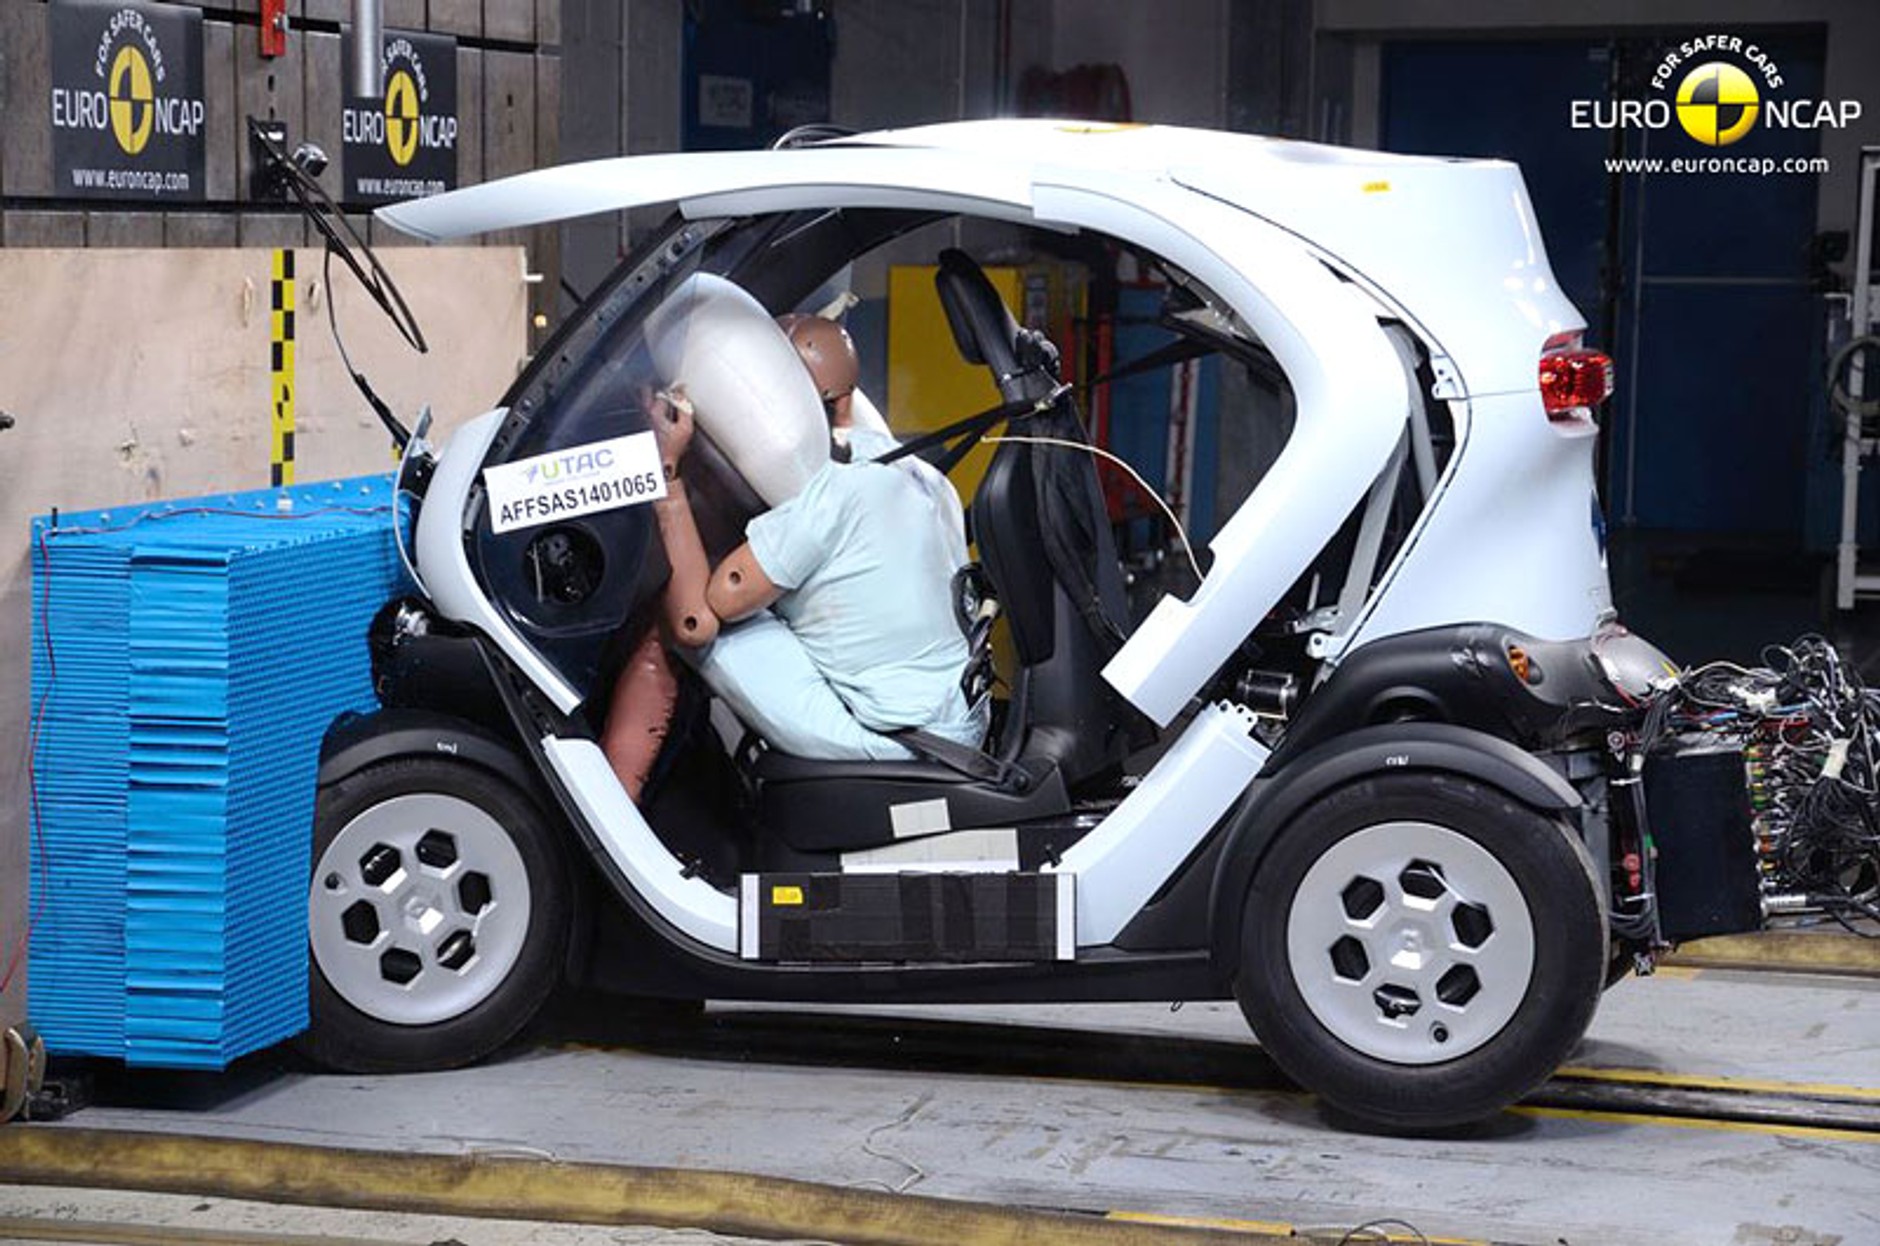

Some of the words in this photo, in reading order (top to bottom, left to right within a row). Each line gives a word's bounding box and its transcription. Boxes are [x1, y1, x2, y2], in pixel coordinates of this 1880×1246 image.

[95, 30, 112, 77] FOR
[110, 9, 144, 37] SAFER
[143, 25, 166, 82] CARS
[52, 89, 108, 129] EURO
[155, 97, 204, 135] NCAP
[343, 109, 384, 145] EURO
[420, 115, 457, 148] NCAP
[72, 168, 189, 194] www.euroncap.com
[541, 449, 614, 479] UTAC
[500, 472, 658, 525] AFFSAS1401065
